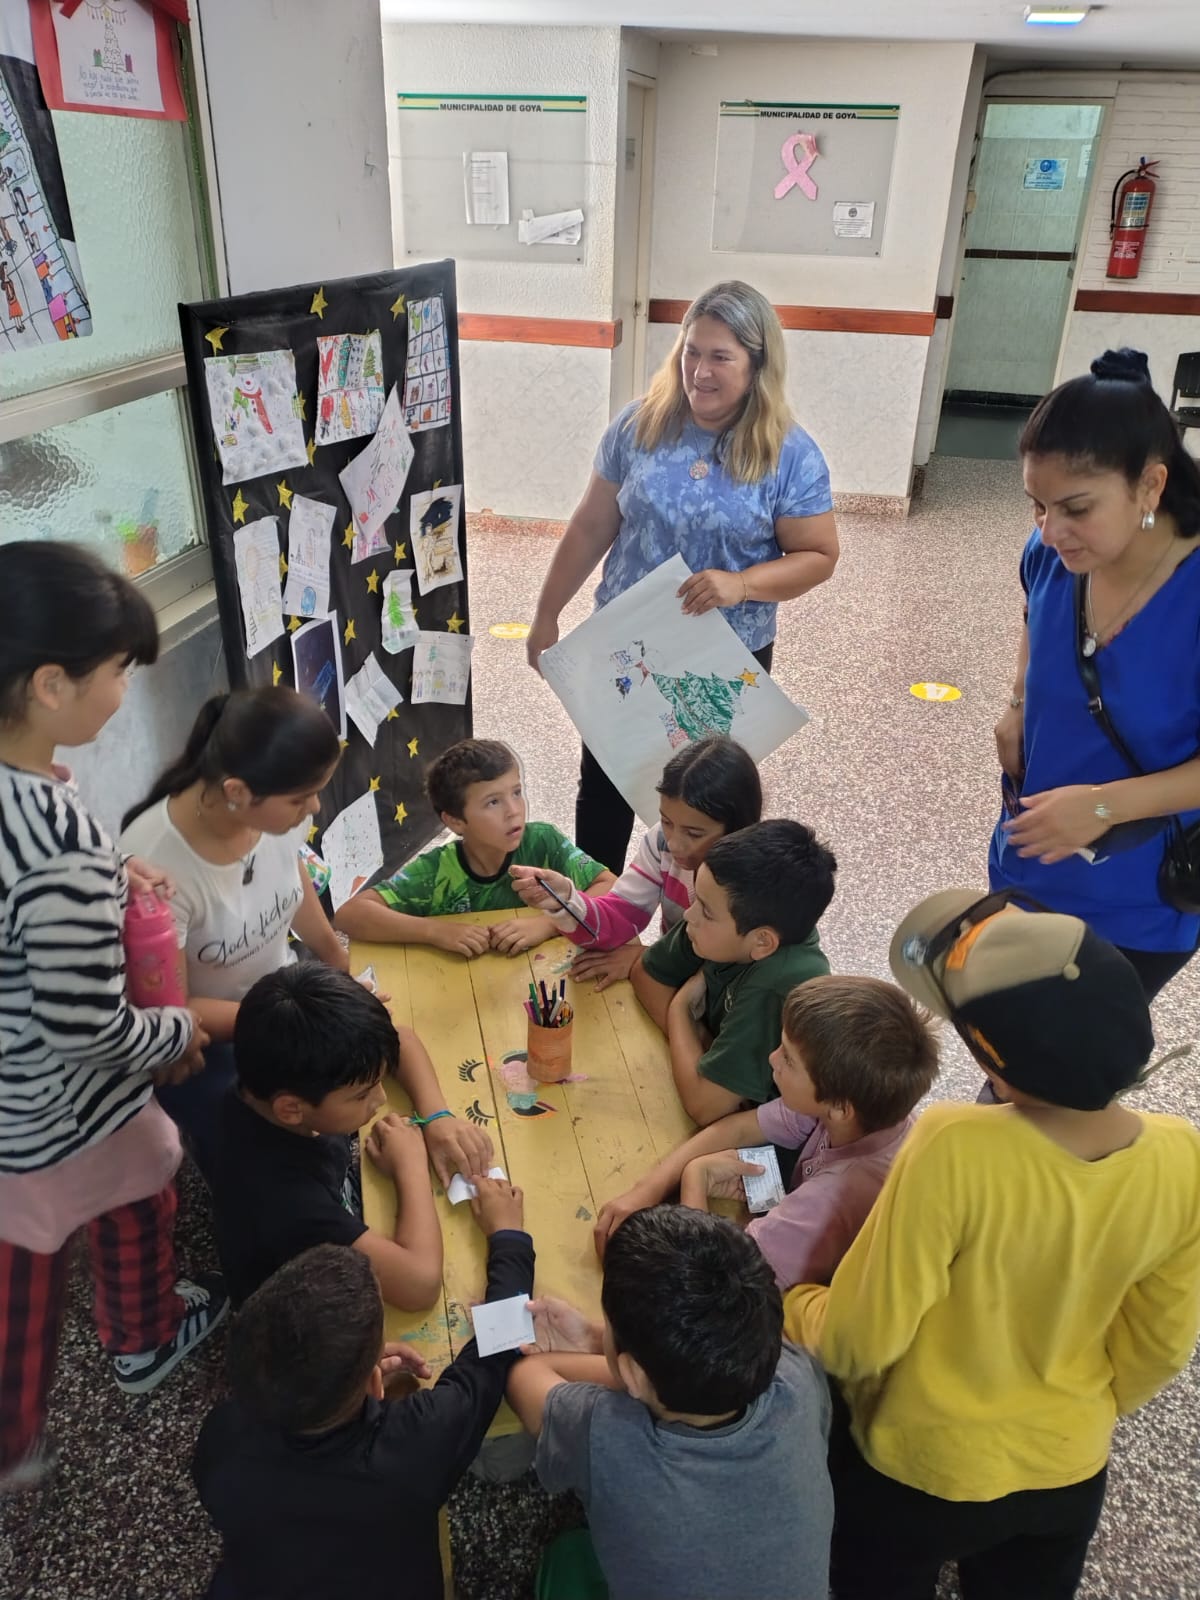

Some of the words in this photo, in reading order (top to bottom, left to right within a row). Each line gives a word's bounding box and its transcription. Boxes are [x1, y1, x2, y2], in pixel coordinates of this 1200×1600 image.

[440, 103, 504, 112] MUNICIPALIDAD
[506, 104, 517, 112] DE
[519, 104, 542, 113] GOYA
[760, 111, 821, 119] MUNICIPALIDAD
[835, 112, 857, 120] GOYA
